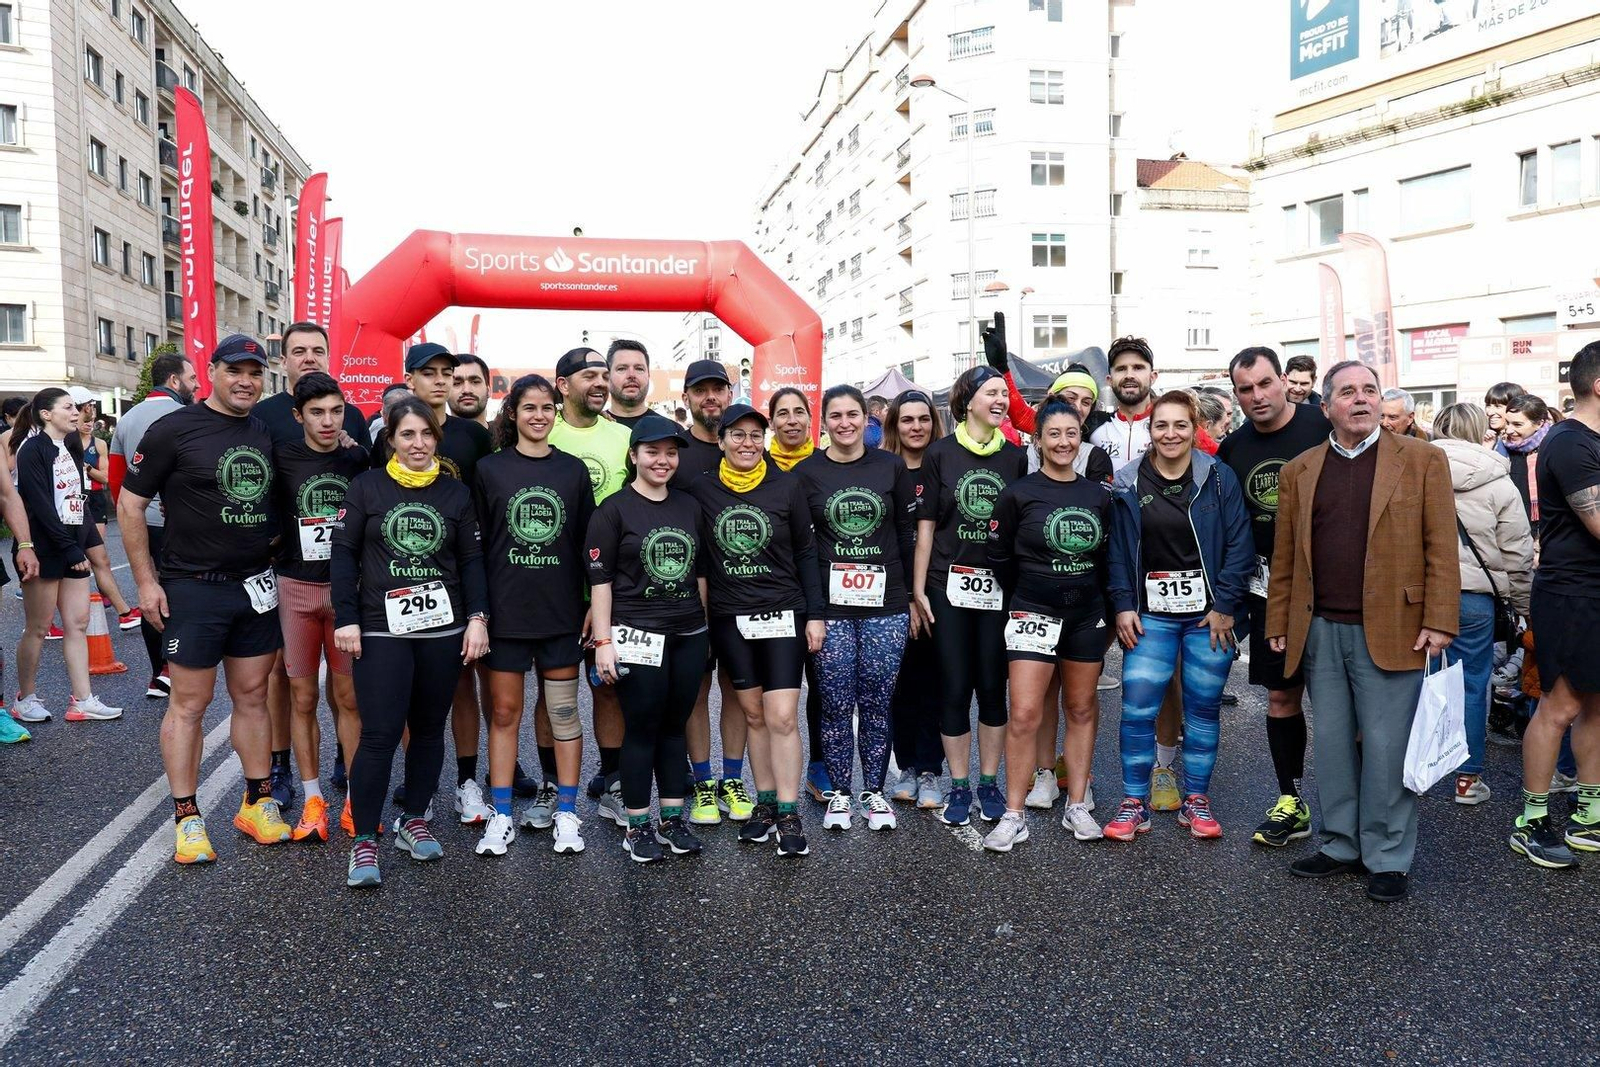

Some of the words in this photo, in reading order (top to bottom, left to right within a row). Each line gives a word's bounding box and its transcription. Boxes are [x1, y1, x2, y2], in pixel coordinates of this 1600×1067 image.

[1300, 30, 1348, 62] McFIT
[465, 248, 540, 275] Sports
[578, 252, 698, 275] Santander
[540, 281, 618, 292] sportssantander.es
[1569, 303, 1595, 317] 5+5
[1513, 340, 1532, 348] RUN
[342, 354, 378, 367] Sports
[775, 364, 807, 376] Sports
[340, 373, 394, 384] Santander
[508, 547, 560, 565] frutorra
[834, 541, 882, 556] frutorra
[389, 560, 443, 577] frutorra
[842, 573, 875, 589] 607
[960, 576, 993, 593] 303
[1158, 580, 1192, 596] 315
[399, 594, 438, 616] 296
[1015, 620, 1048, 638] 305
[617, 628, 652, 647] 344
